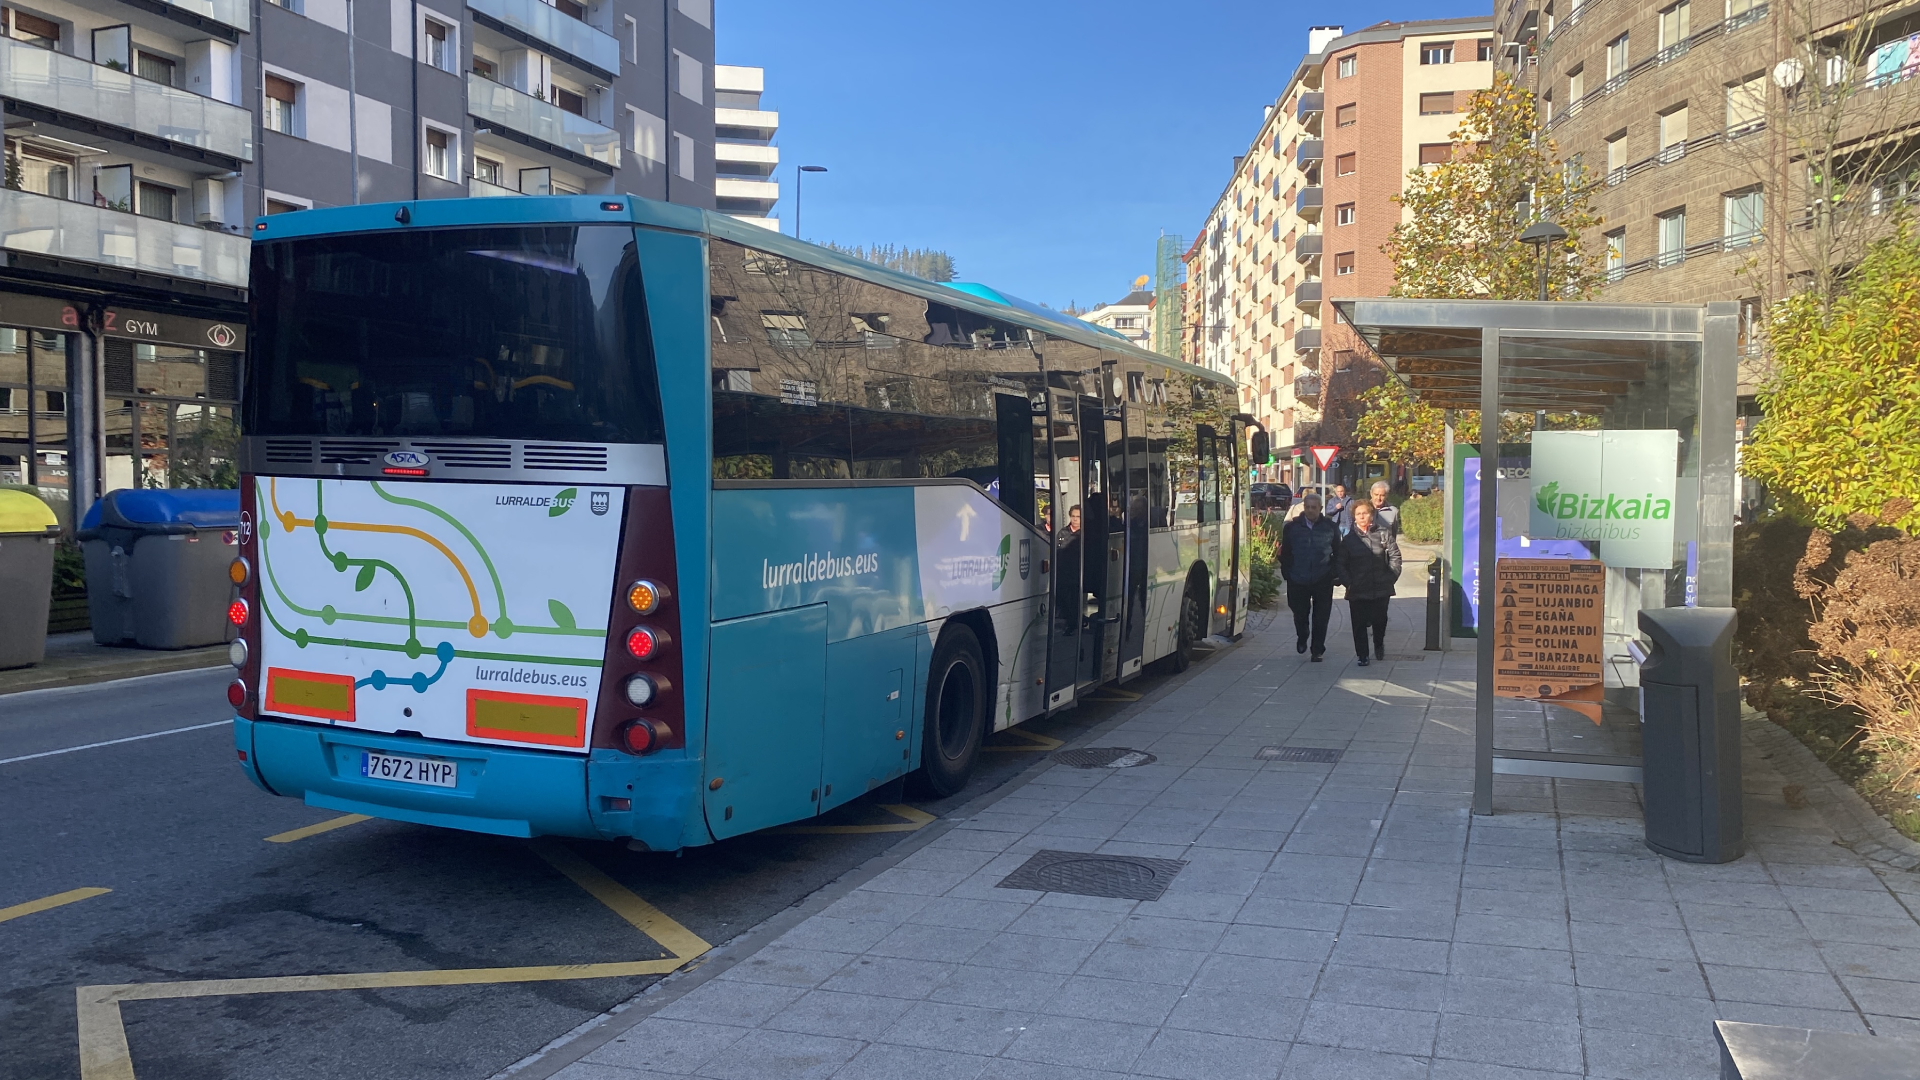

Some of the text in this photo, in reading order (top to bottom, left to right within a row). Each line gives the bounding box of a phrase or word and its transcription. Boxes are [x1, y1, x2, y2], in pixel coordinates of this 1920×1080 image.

[125, 319, 158, 336] GYM
[390, 452, 422, 464] ASTRAL
[495, 495, 577, 508] LURRALDEBUS
[1557, 493, 1671, 520] Bizkaia
[240, 521, 251, 535] 712
[1555, 522, 1641, 540] bizkaibus
[762, 551, 878, 589] lurraldebus.eus
[1535, 583, 1599, 595] ITURRIAGA
[1535, 597, 1594, 608] LUJANBIO
[1535, 609, 1575, 621] EGAÑA
[1535, 624, 1597, 636] ARAMENDI
[1535, 638, 1579, 649] COLINA
[1535, 651, 1601, 664] IBARZABAL
[475, 665, 588, 687] lurraldebus.eus
[371, 755, 413, 780] 7672
[418, 761, 452, 784] HYP
